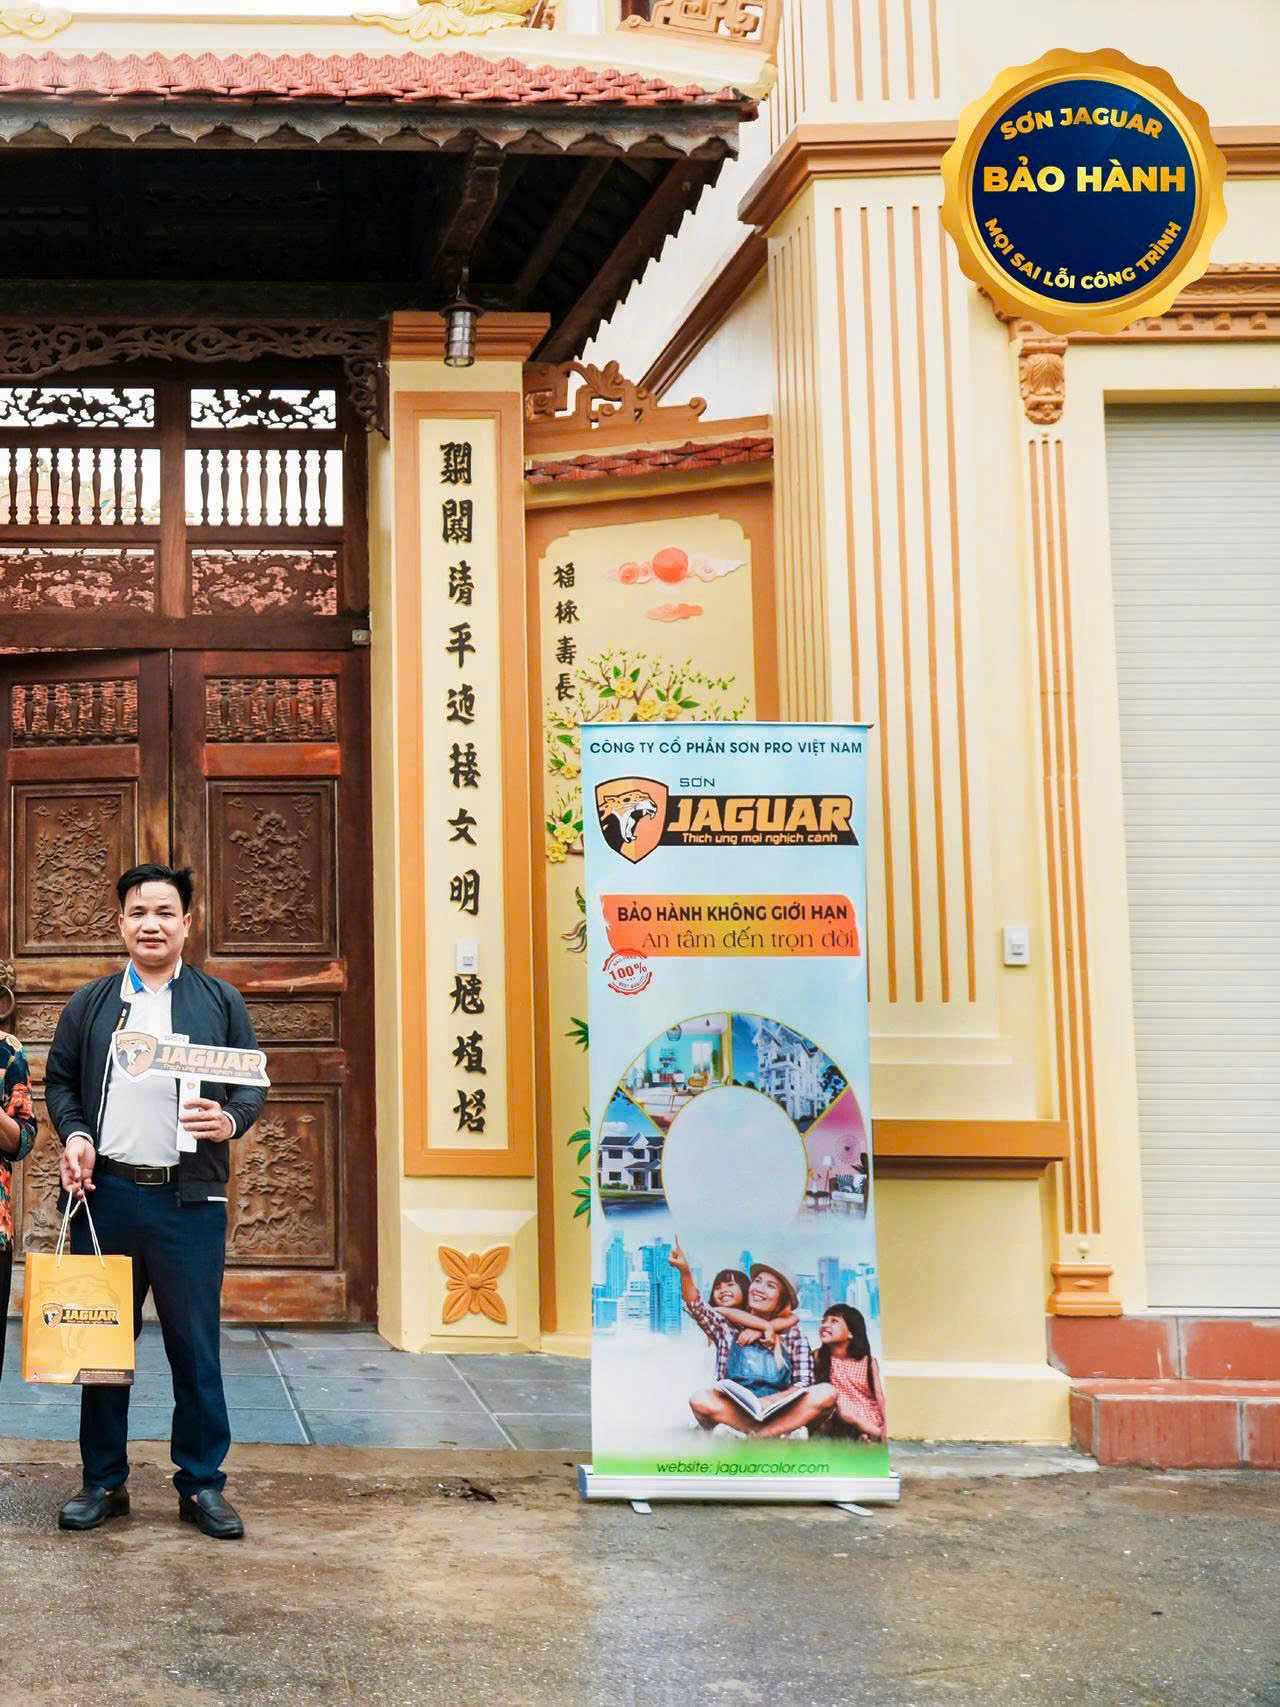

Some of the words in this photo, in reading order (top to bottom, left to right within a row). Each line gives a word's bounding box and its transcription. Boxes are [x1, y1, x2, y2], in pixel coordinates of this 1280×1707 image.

[589, 739, 635, 754] CÔNG
[640, 742, 655, 753] TY
[659, 736, 682, 754] CỔ
[729, 741, 761, 754] SƠN
[764, 742, 794, 754] PRO
[798, 739, 826, 756] VIỆT
[831, 742, 863, 754] NAM
[679, 776, 716, 787] SƠN
[667, 798, 853, 832] JAGUAR
[617, 901, 652, 922] BẢO
[656, 902, 702, 922] HÀNH
[707, 902, 768, 921] KHÔNG
[771, 901, 806, 921] GIỚI
[811, 905, 848, 924] HẠN
[642, 930, 669, 948] An
[677, 929, 716, 948] tâm
[722, 926, 764, 949] đến
[771, 931, 813, 952] trọn
[821, 928, 855, 949] đời
[158, 1046, 262, 1073] JAGUAR
[63, 1310, 117, 1321] JAGUAR
[656, 1461, 713, 1473] website:
[715, 1461, 830, 1475] jaguarcolor.com
